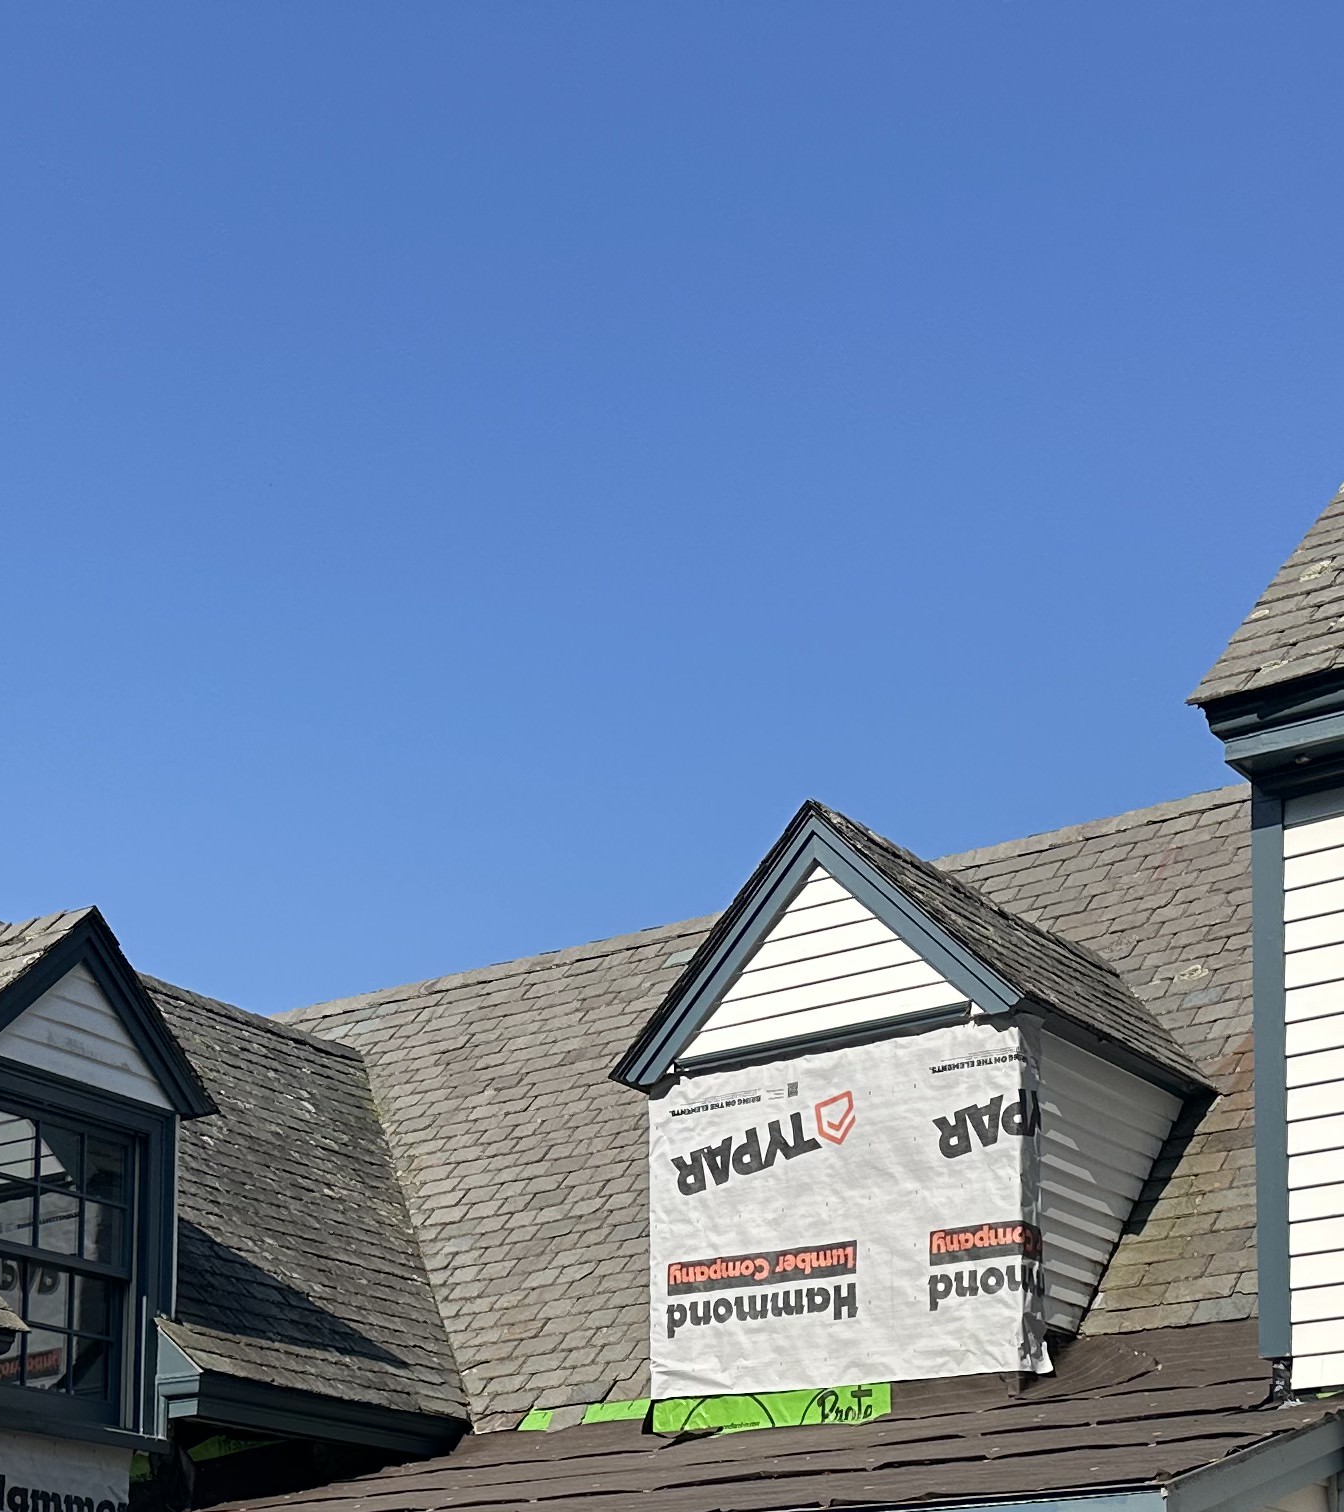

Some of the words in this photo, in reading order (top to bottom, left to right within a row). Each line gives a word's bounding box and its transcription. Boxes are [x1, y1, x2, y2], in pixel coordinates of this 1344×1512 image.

[976, 1057, 993, 1067] THE
[671, 1112, 823, 1196] TYPAR
[669, 1257, 771, 1286] Company
[775, 1246, 855, 1275] Lumber
[666, 1282, 858, 1339] Hammond
